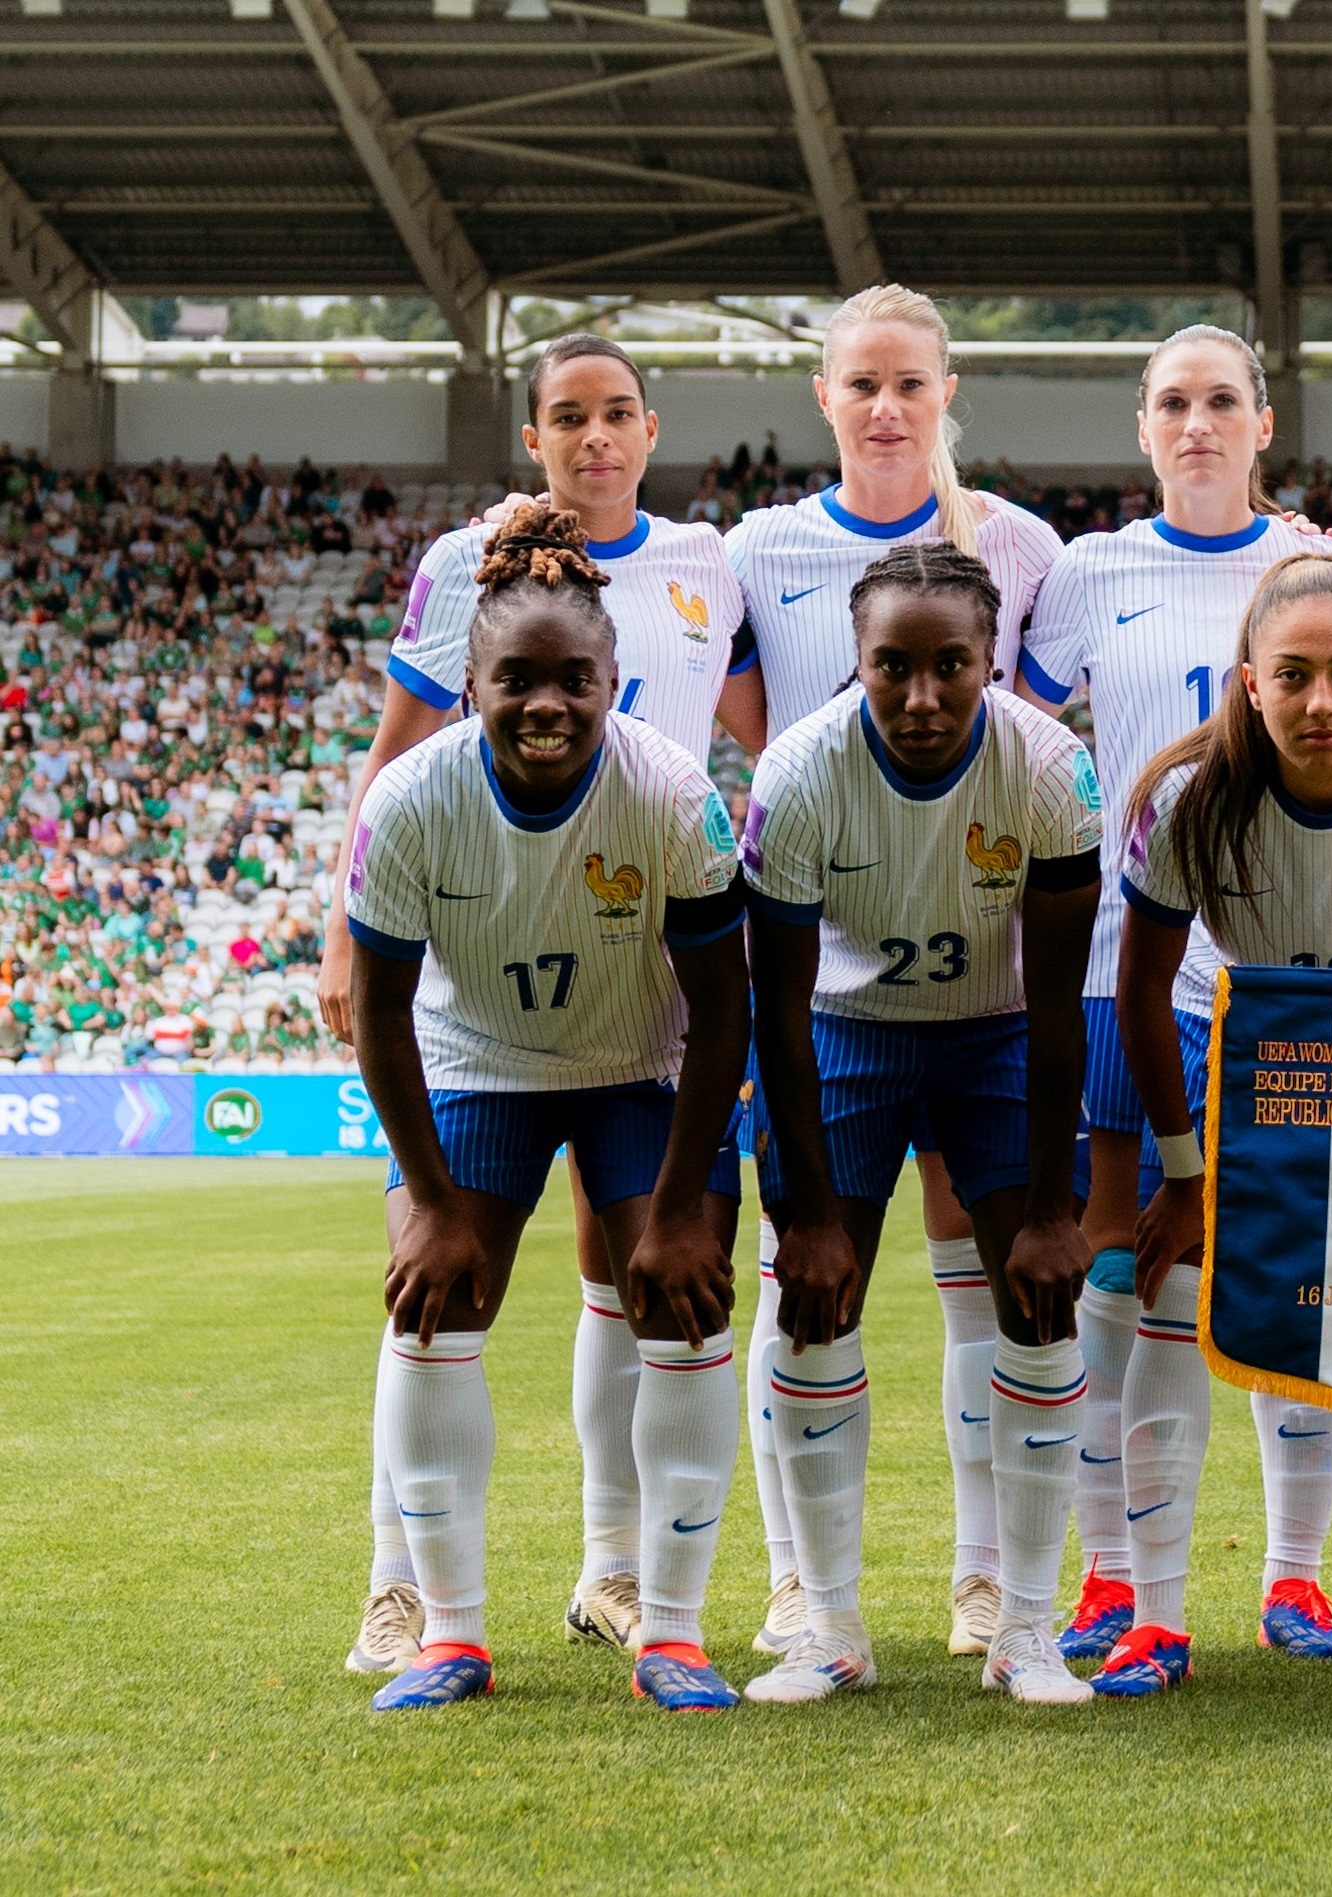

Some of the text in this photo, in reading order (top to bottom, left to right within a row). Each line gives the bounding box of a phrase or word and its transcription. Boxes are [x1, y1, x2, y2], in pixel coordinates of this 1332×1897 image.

[878, 931, 969, 986] 23
[503, 952, 579, 1012] 17
[1257, 1041, 1296, 1062] UEFA
[1253, 1070, 1326, 1093] EQUIPE
[212, 1101, 254, 1129] FAI
[1296, 1285, 1320, 1306] 16
